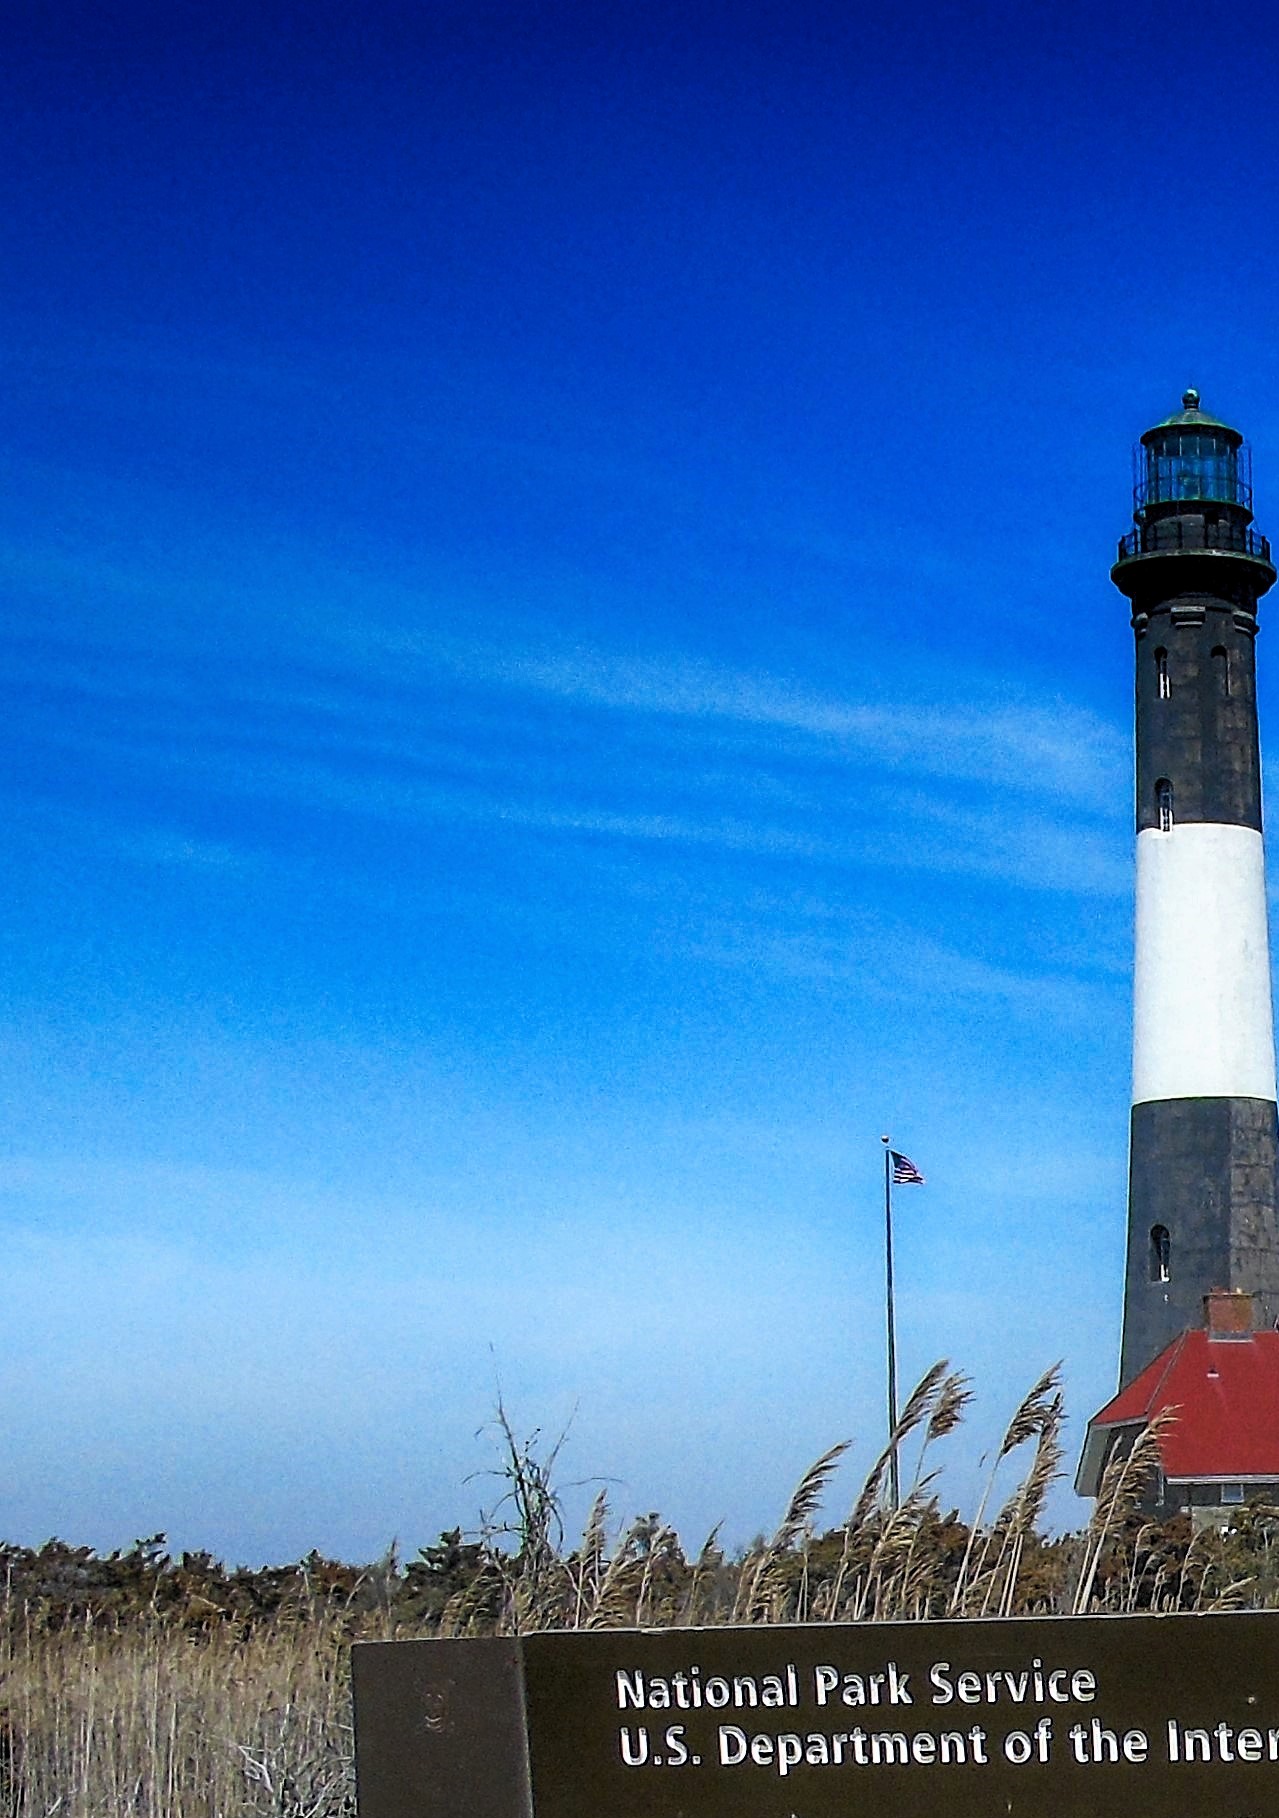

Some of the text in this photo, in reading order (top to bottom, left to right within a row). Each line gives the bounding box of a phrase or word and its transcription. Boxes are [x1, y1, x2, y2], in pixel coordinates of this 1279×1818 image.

[615, 1658, 1098, 1708] National Park Service
[620, 1725, 702, 1765] U.S.
[718, 1724, 989, 1776] Department
[1003, 1719, 1053, 1764] of
[1069, 1719, 1148, 1763] the
